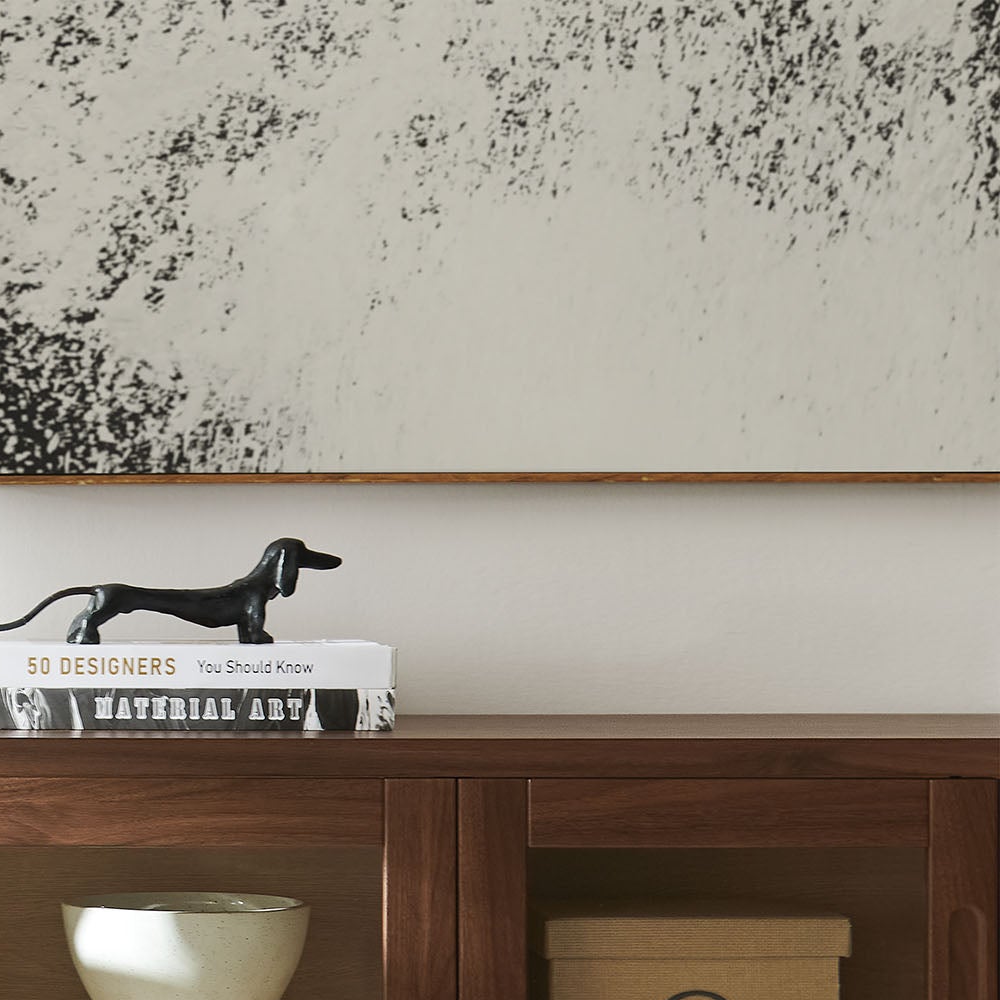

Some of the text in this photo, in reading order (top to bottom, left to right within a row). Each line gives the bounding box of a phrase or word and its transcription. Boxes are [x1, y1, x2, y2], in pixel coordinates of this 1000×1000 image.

[27, 657, 315, 676] 50 DESIGNERS You Should Know
[94, 696, 303, 721] MATERIAL ART
